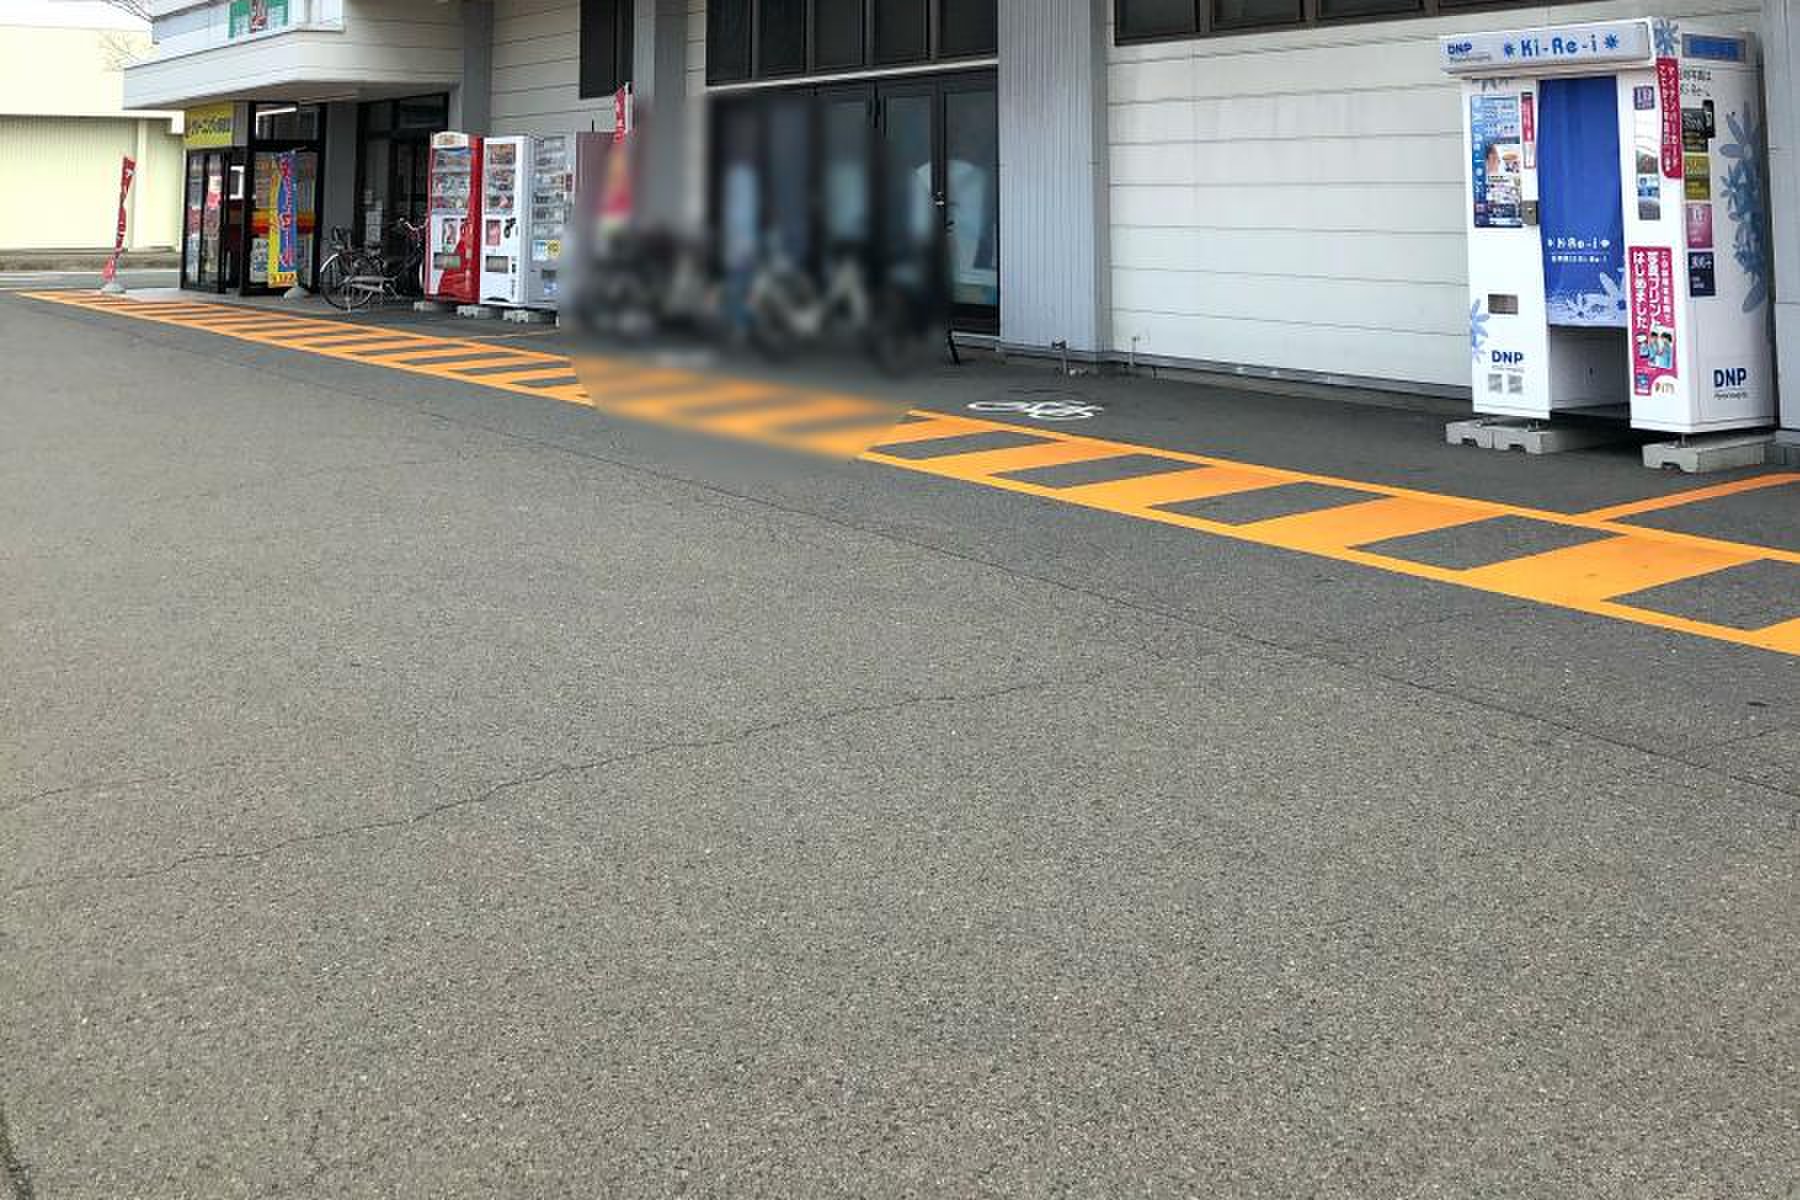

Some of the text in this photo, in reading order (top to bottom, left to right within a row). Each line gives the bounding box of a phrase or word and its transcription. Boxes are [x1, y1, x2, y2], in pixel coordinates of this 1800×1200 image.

[1446, 41, 1473, 55] DNP
[1519, 33, 1598, 57] Ki-Re-i
[1491, 350, 1524, 364] DNP
[1713, 367, 1747, 388] DNP
